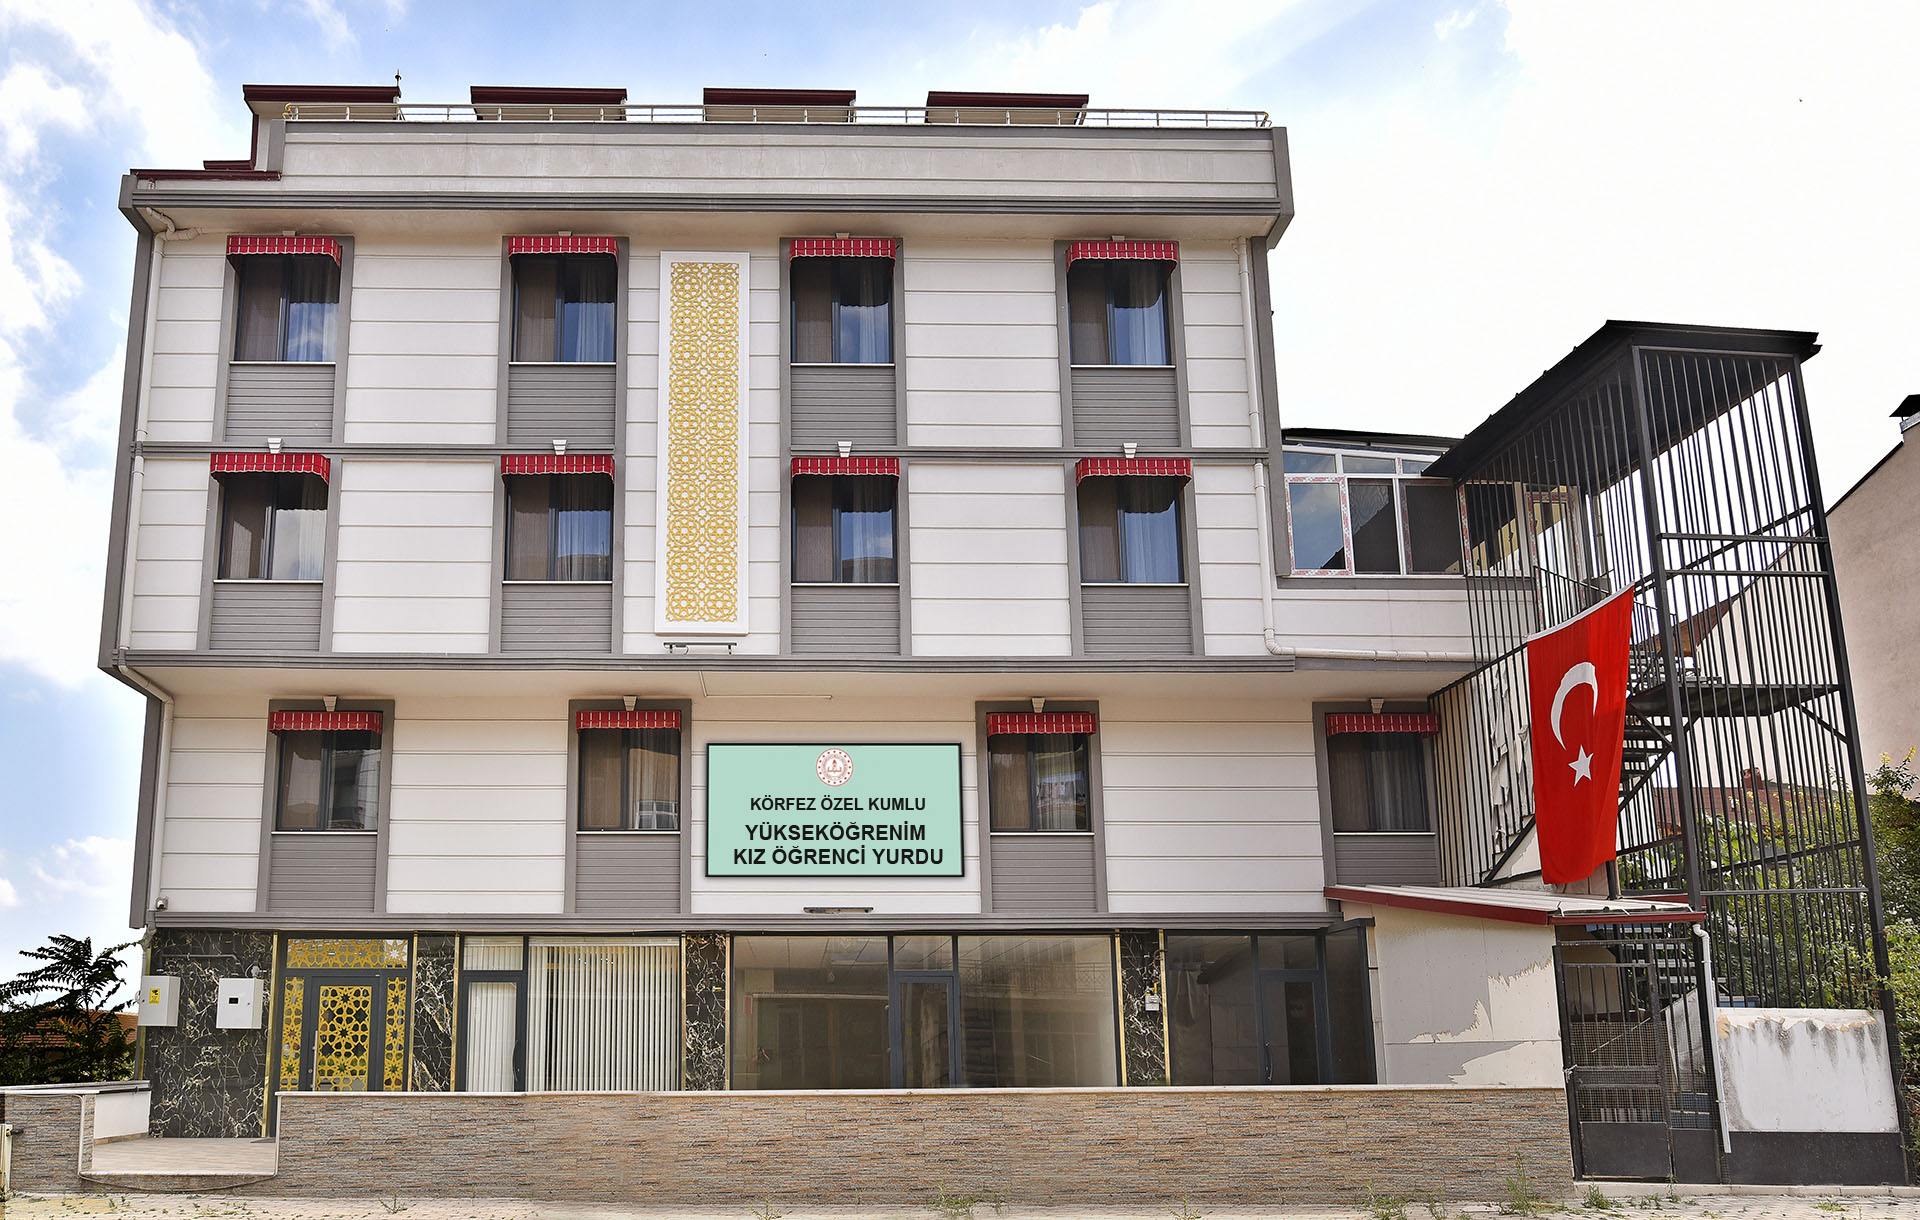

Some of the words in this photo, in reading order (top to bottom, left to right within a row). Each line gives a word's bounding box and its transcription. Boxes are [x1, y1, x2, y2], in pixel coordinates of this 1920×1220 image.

[750, 794, 817, 811] KÖRFEZ
[820, 794, 864, 811] ÖZEL
[868, 797, 926, 811] KUMLU
[744, 820, 926, 841] YÜKSEKÖĞRENİM
[733, 848, 766, 865] KIZ
[771, 844, 866, 865] ÖĞRENCİ
[871, 848, 943, 865] YURDU
